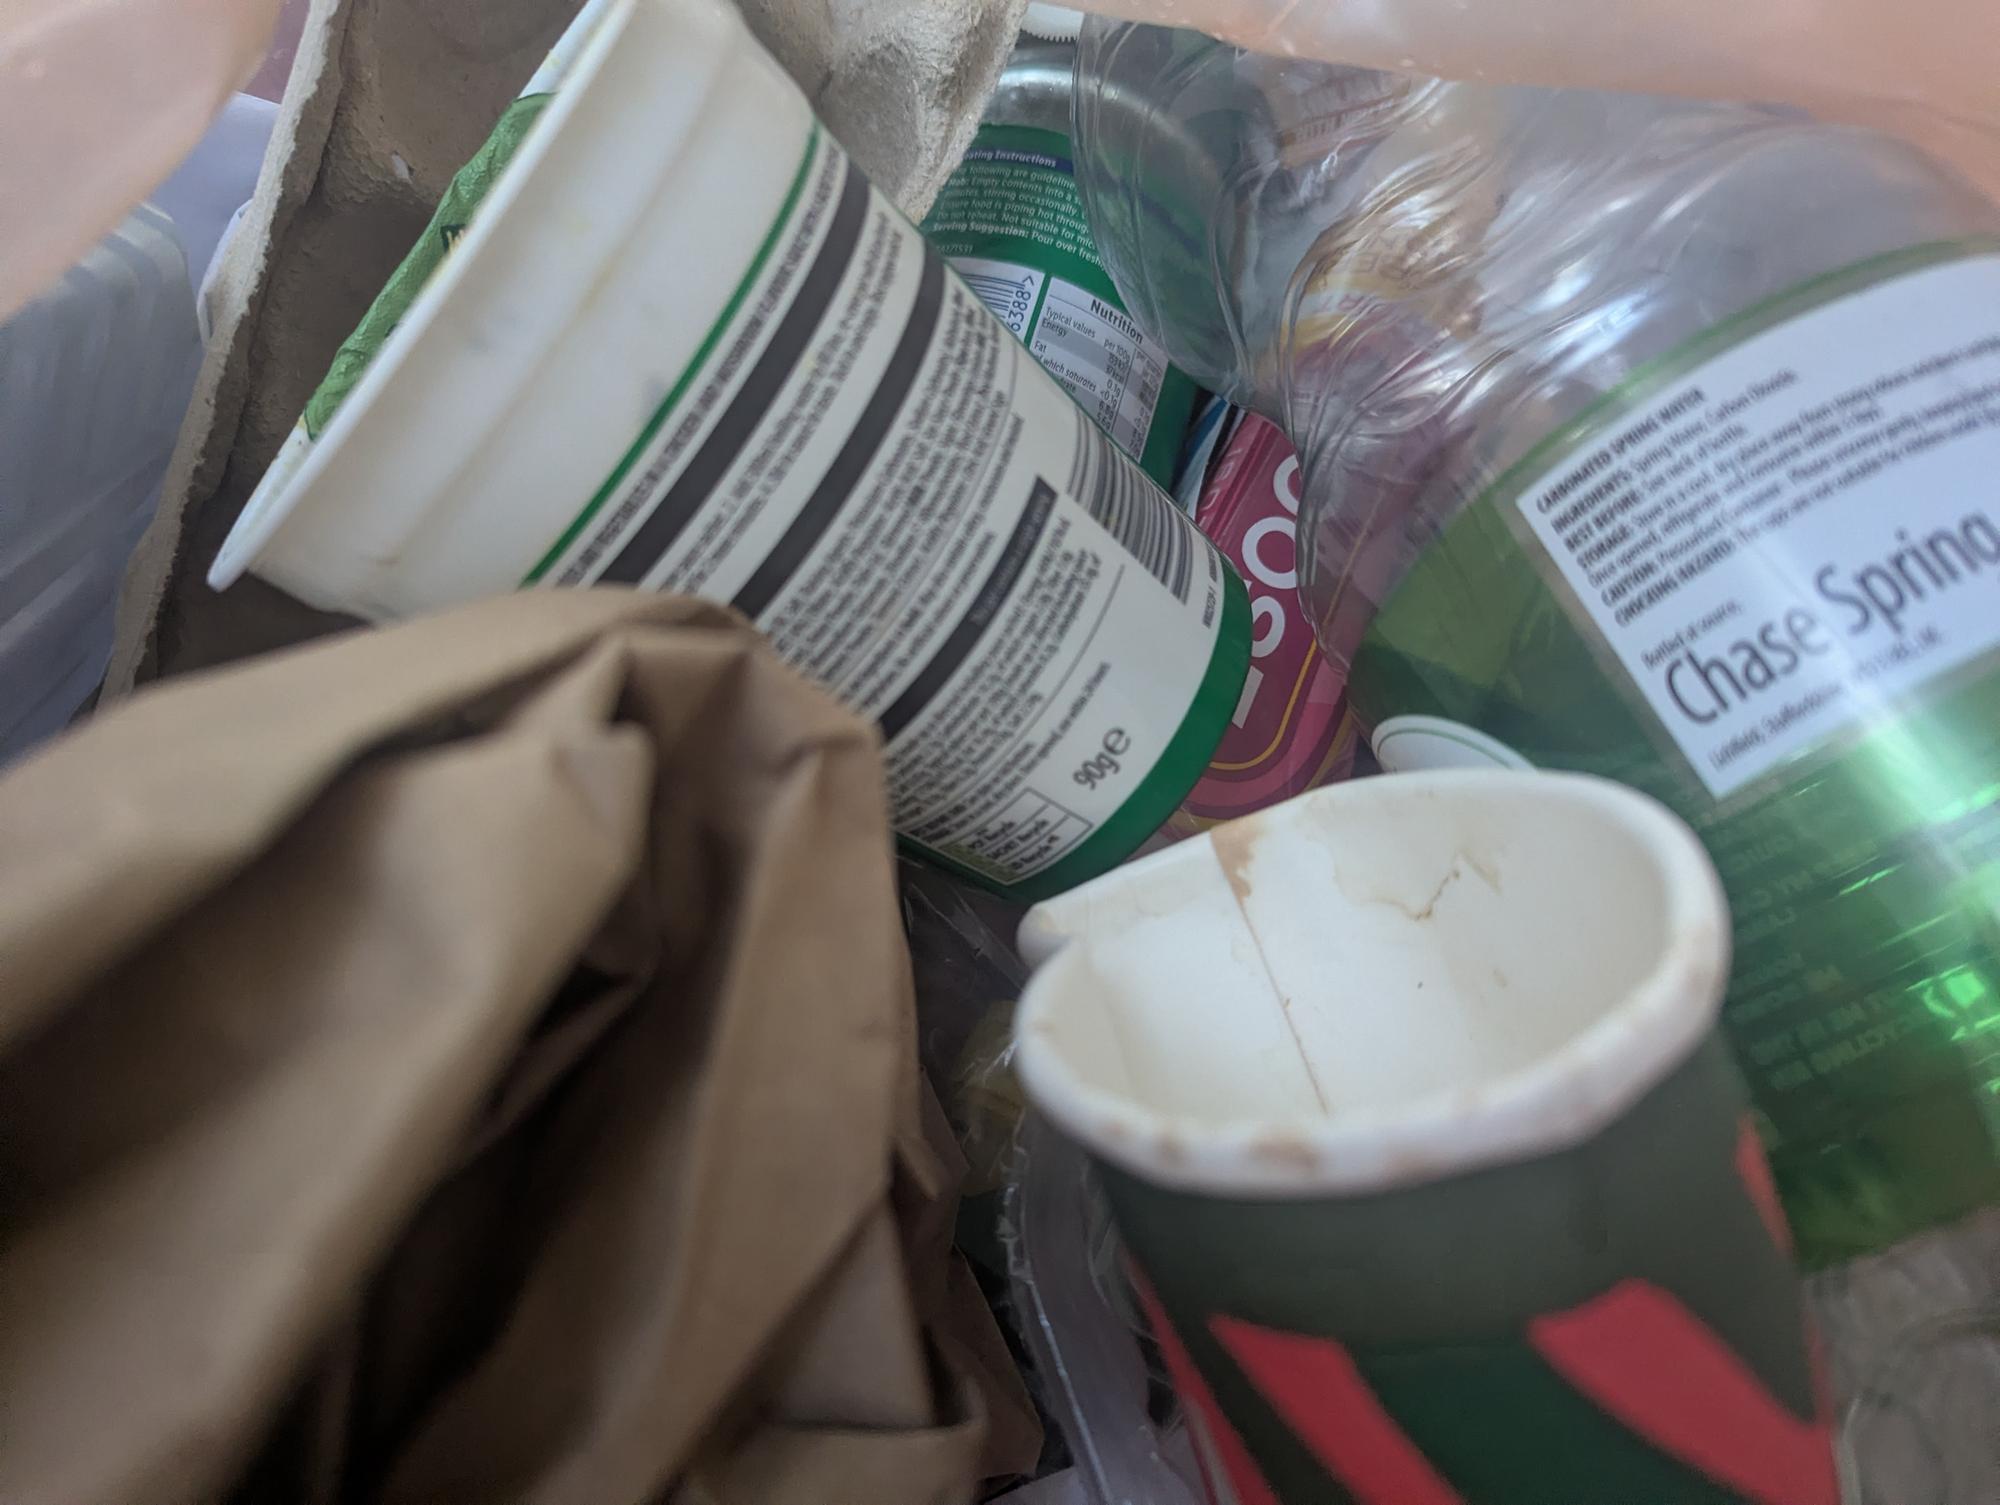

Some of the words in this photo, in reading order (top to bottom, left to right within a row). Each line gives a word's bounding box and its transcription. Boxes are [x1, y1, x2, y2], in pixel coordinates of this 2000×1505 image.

[995, 151, 1057, 169] Instructions
[1014, 169, 1029, 178] are
[971, 177, 999, 188] Empty
[1001, 178, 1043, 193] contents
[1045, 185, 1064, 199] into
[1004, 202, 1036, 217] piping
[1037, 207, 1053, 221] hot
[1056, 215, 1091, 235] throug
[1018, 194, 1079, 218] occasionally.
[1001, 213, 1020, 225] Not
[1021, 216, 1060, 235] suitable
[1061, 228, 1076, 240] for
[933, 222, 967, 233] Serving
[969, 221, 1029, 239] Suggestion:
[1031, 230, 1054, 247] Pour
[1055, 240, 1078, 254] over
[1078, 248, 1105, 272] fresh
[1041, 318, 1068, 338] Energy
[1046, 306, 1072, 327] Typical
[1073, 320, 1096, 339] values
[1090, 298, 1144, 345] Nutrition
[1034, 340, 1047, 353] Fat
[1106, 379, 1121, 397] 0.1g
[1043, 358, 1066, 375] which
[1065, 368, 1098, 394] saturates
[1609, 416, 1660, 457] SPRING
[1562, 522, 1596, 552] BEST
[1663, 607, 1833, 726] Chase
